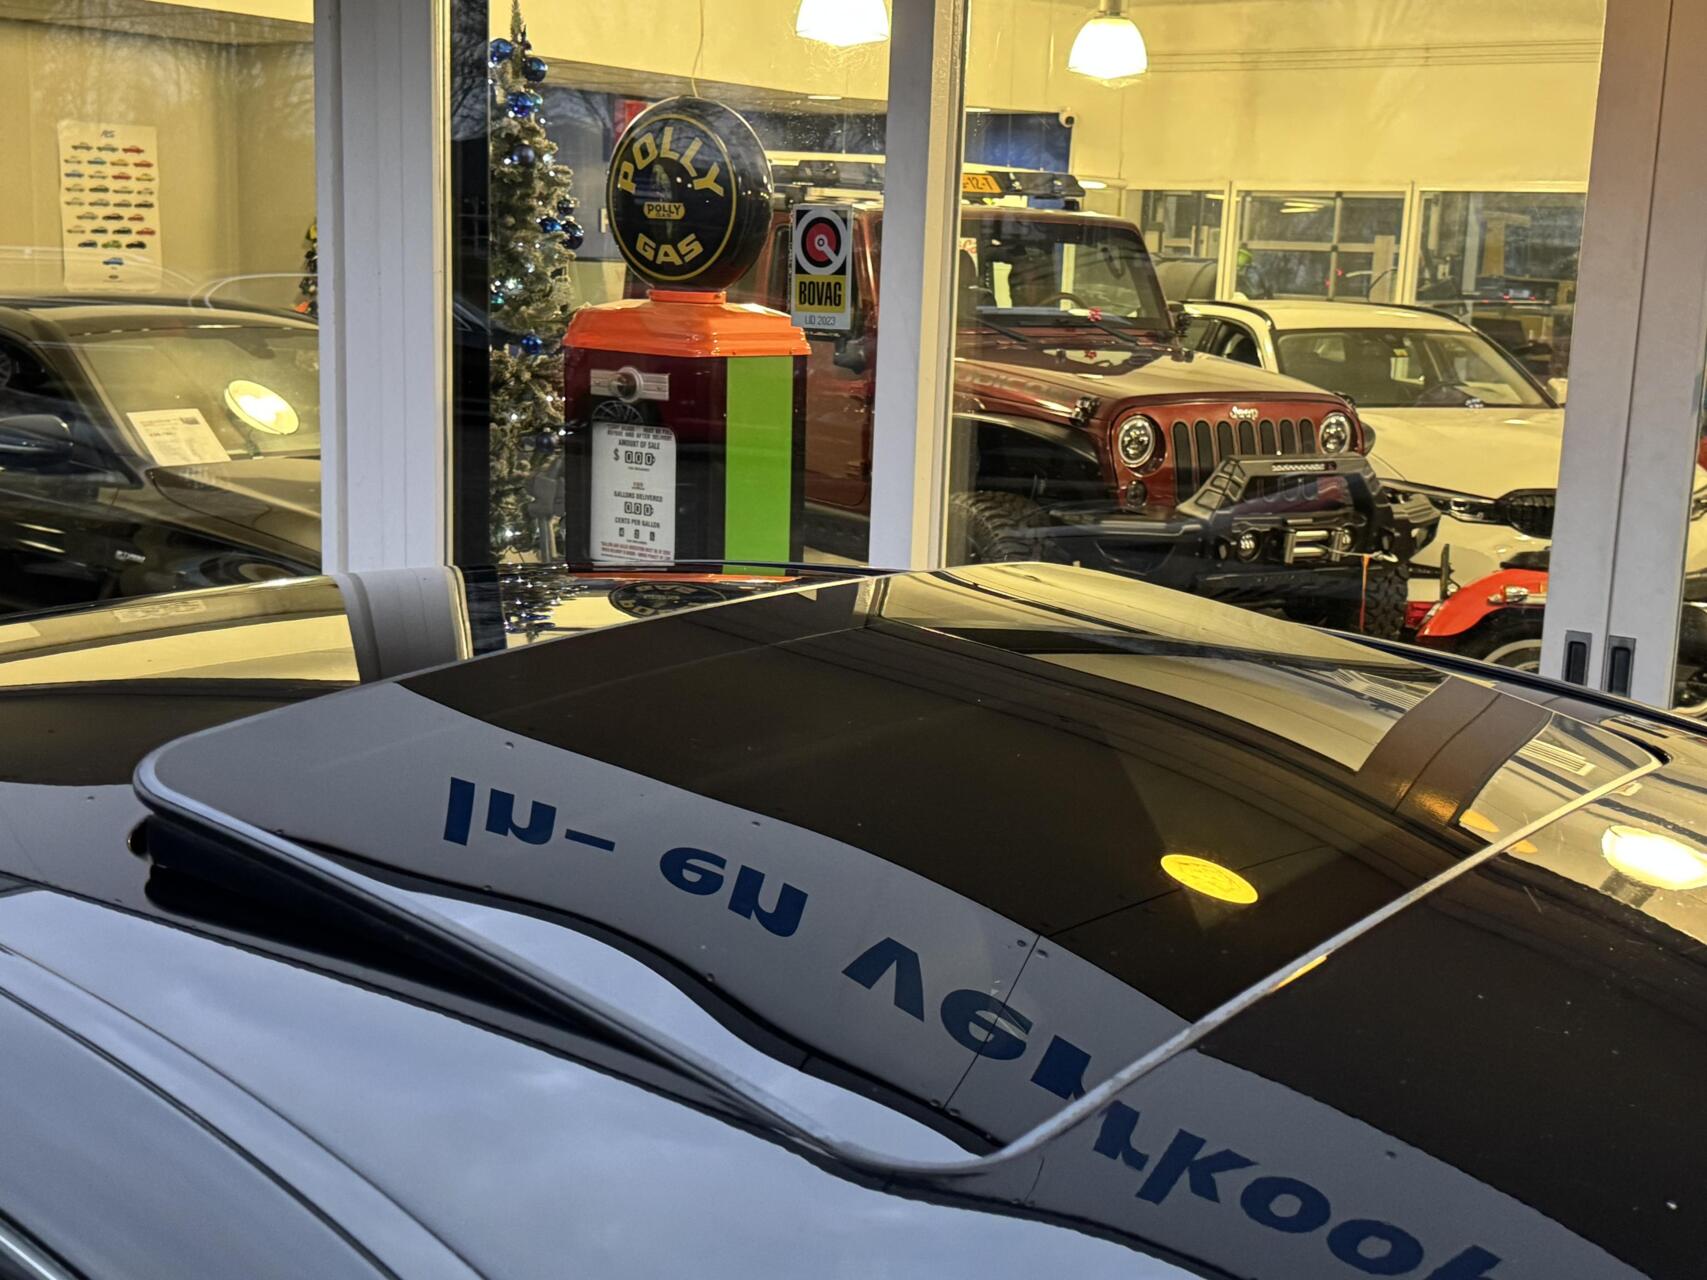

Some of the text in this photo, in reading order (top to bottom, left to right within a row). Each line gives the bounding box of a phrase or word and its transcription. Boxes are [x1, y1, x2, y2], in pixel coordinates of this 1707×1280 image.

[617, 126, 724, 197] POLLY
[647, 203, 681, 216] POLLY
[635, 232, 703, 266] GAS
[799, 281, 842, 307] BOVAG
[1229, 405, 1259, 420] Jeep
[613, 448, 620, 461] $
[636, 494, 663, 502] DELIVERED
